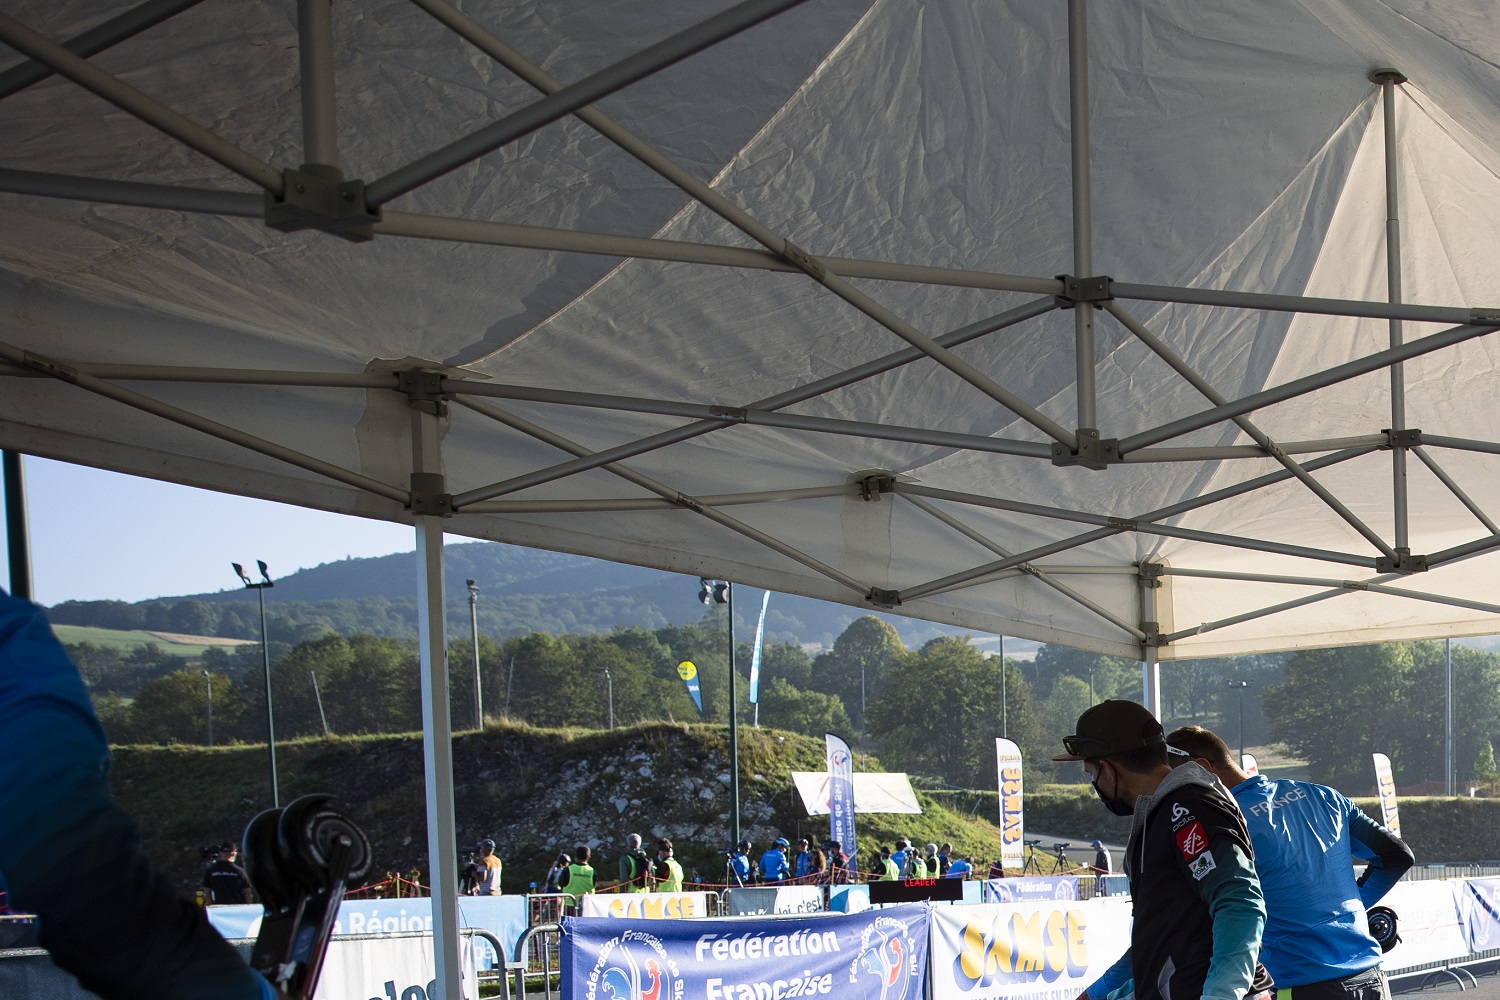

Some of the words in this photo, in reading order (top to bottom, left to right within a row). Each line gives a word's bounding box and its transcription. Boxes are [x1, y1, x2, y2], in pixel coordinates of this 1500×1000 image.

[1249, 788, 1306, 816] FRANCE
[904, 877, 936, 887] LEADER
[1016, 882, 1053, 893] Fédération
[621, 929, 668, 961] Française
[666, 959, 680, 978] de
[695, 928, 841, 962] Fédération
[953, 909, 1088, 992] SAMSE
